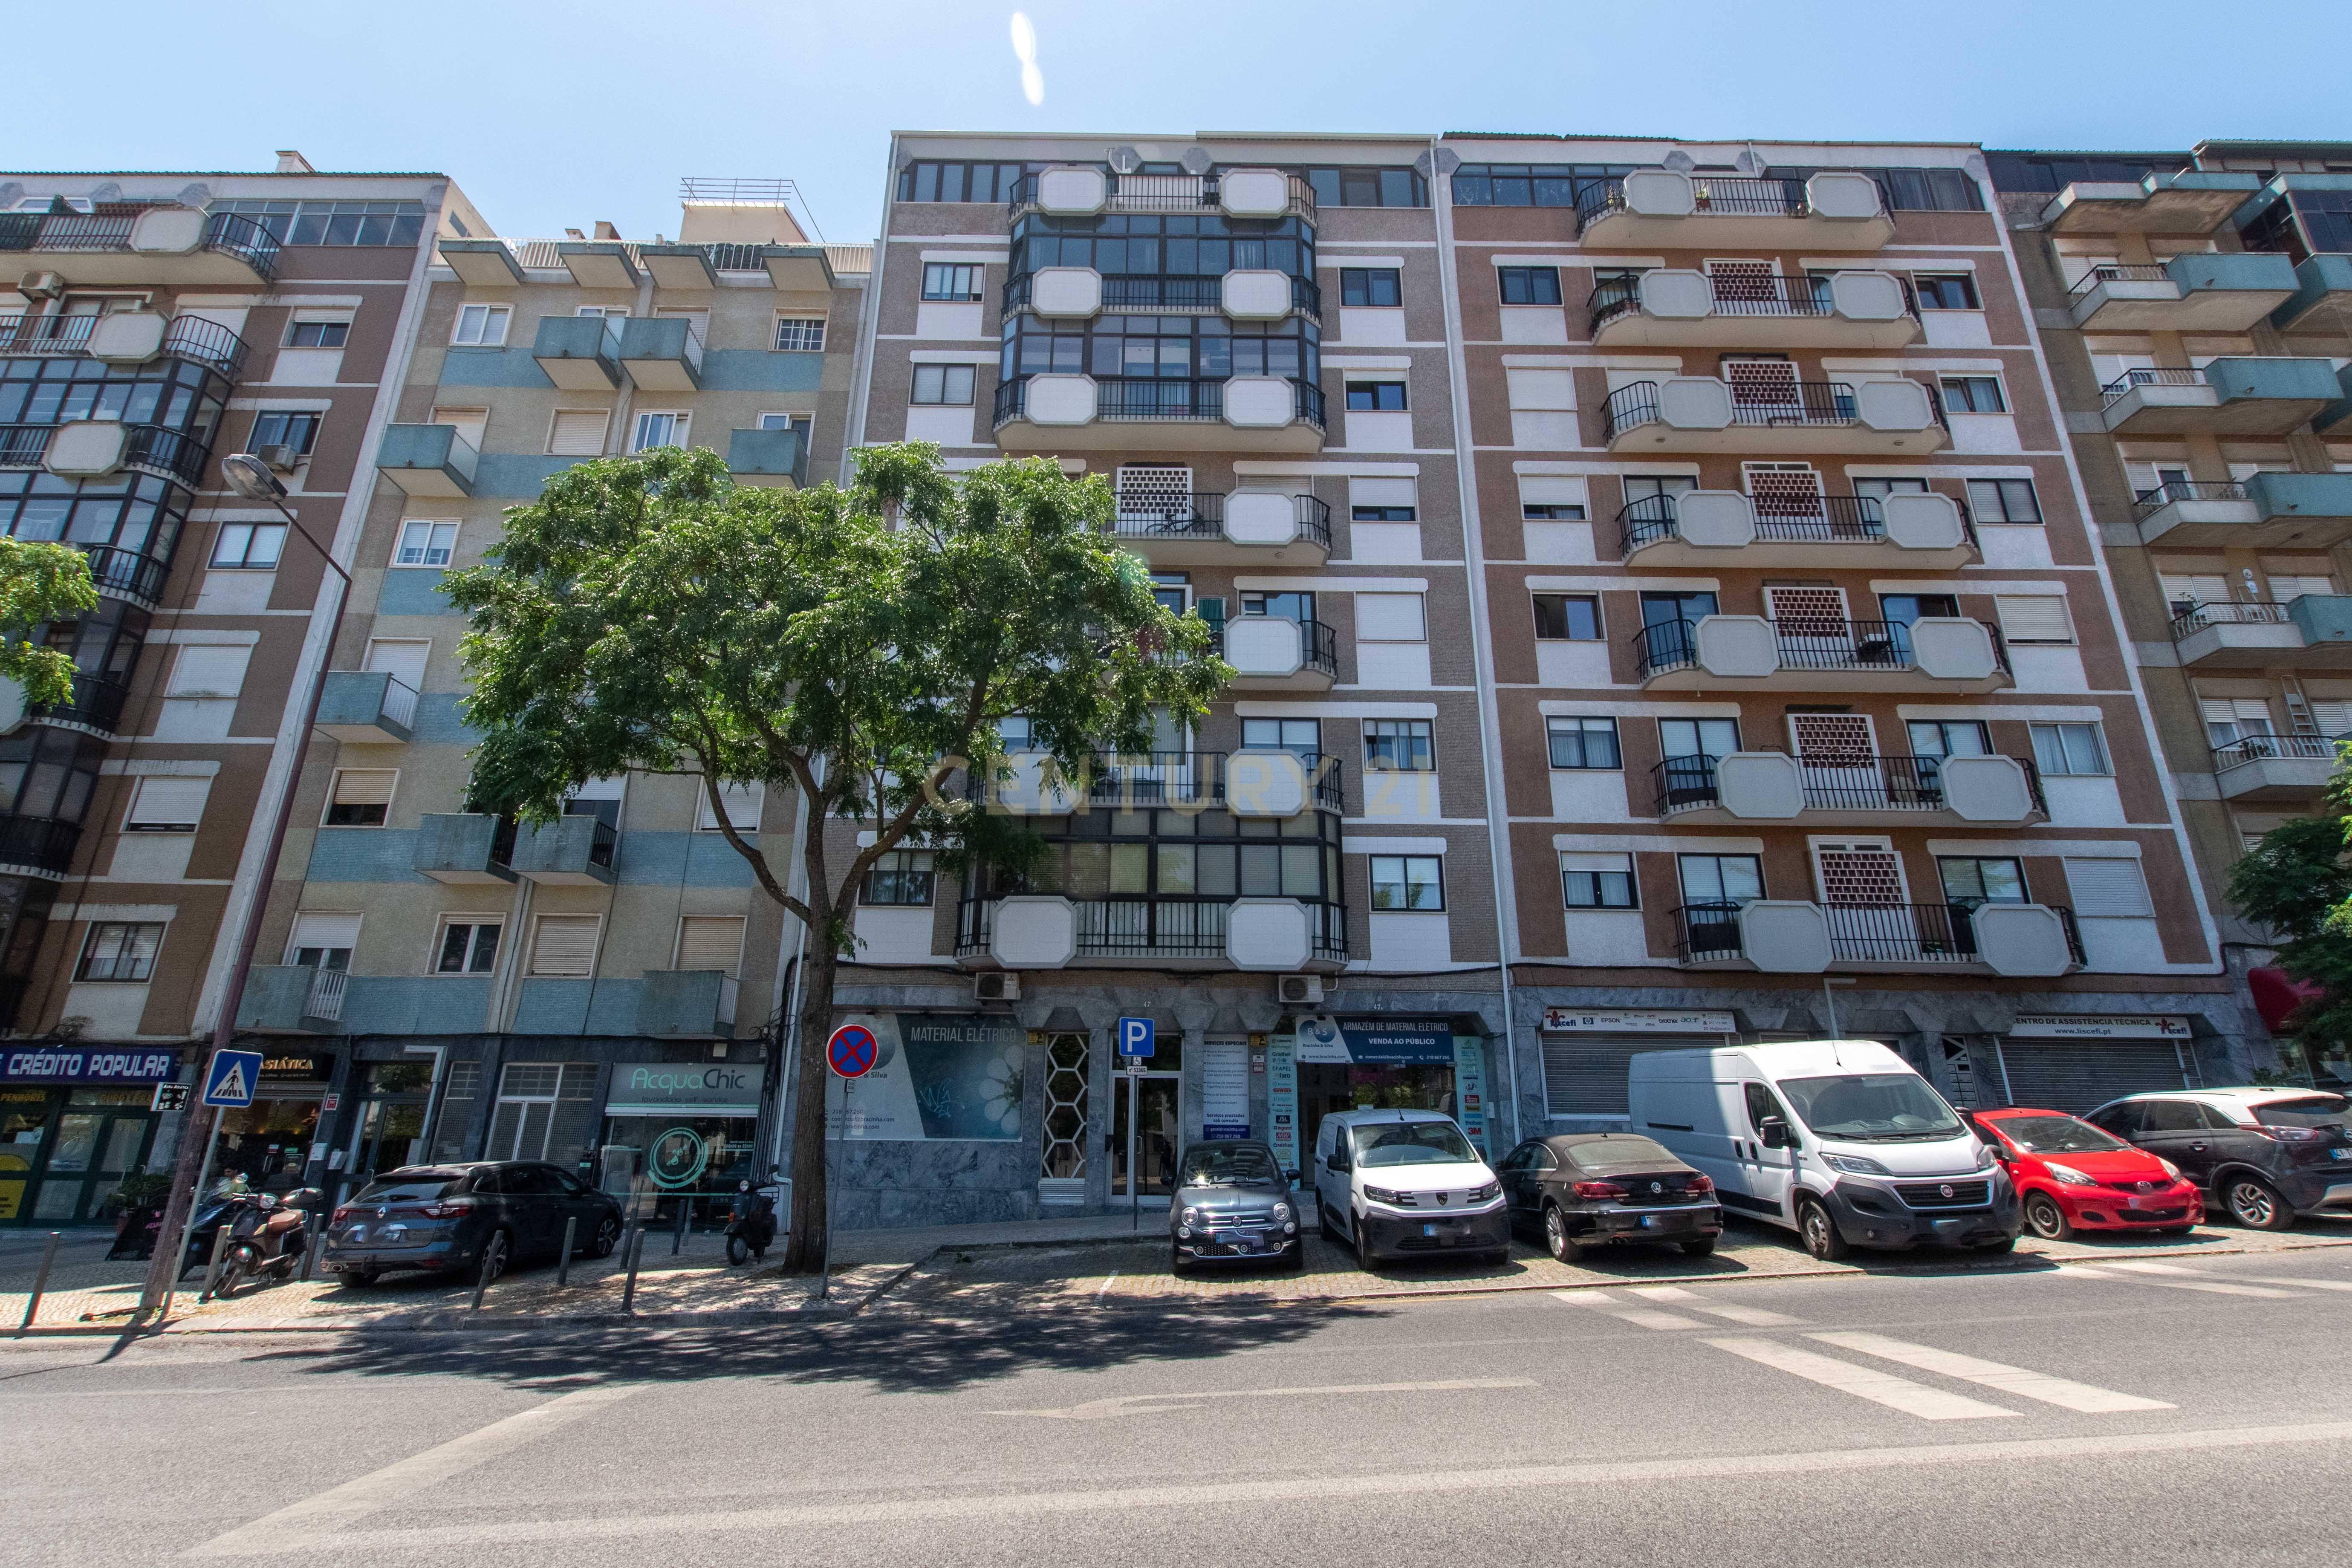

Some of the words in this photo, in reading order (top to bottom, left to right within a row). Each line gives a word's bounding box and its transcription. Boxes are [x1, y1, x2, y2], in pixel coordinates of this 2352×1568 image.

[910, 1026, 963, 1042] MATERIAL
[966, 1023, 1017, 1042] ELÉTRICO
[1343, 1020, 1375, 1031] ARMAZÉM
[1376, 1022, 1385, 1031] DE
[1386, 1022, 1417, 1031] MATERIAL
[1419, 1021, 1448, 1031] ELÉTRICO
[1127, 1021, 1147, 1052] P
[1405, 1037, 1435, 1045] PÚBLICO
[8, 1048, 83, 1076] CRÉDITO
[87, 1054, 170, 1077] POPULAR
[1468, 1127, 1482, 1135] 3M
